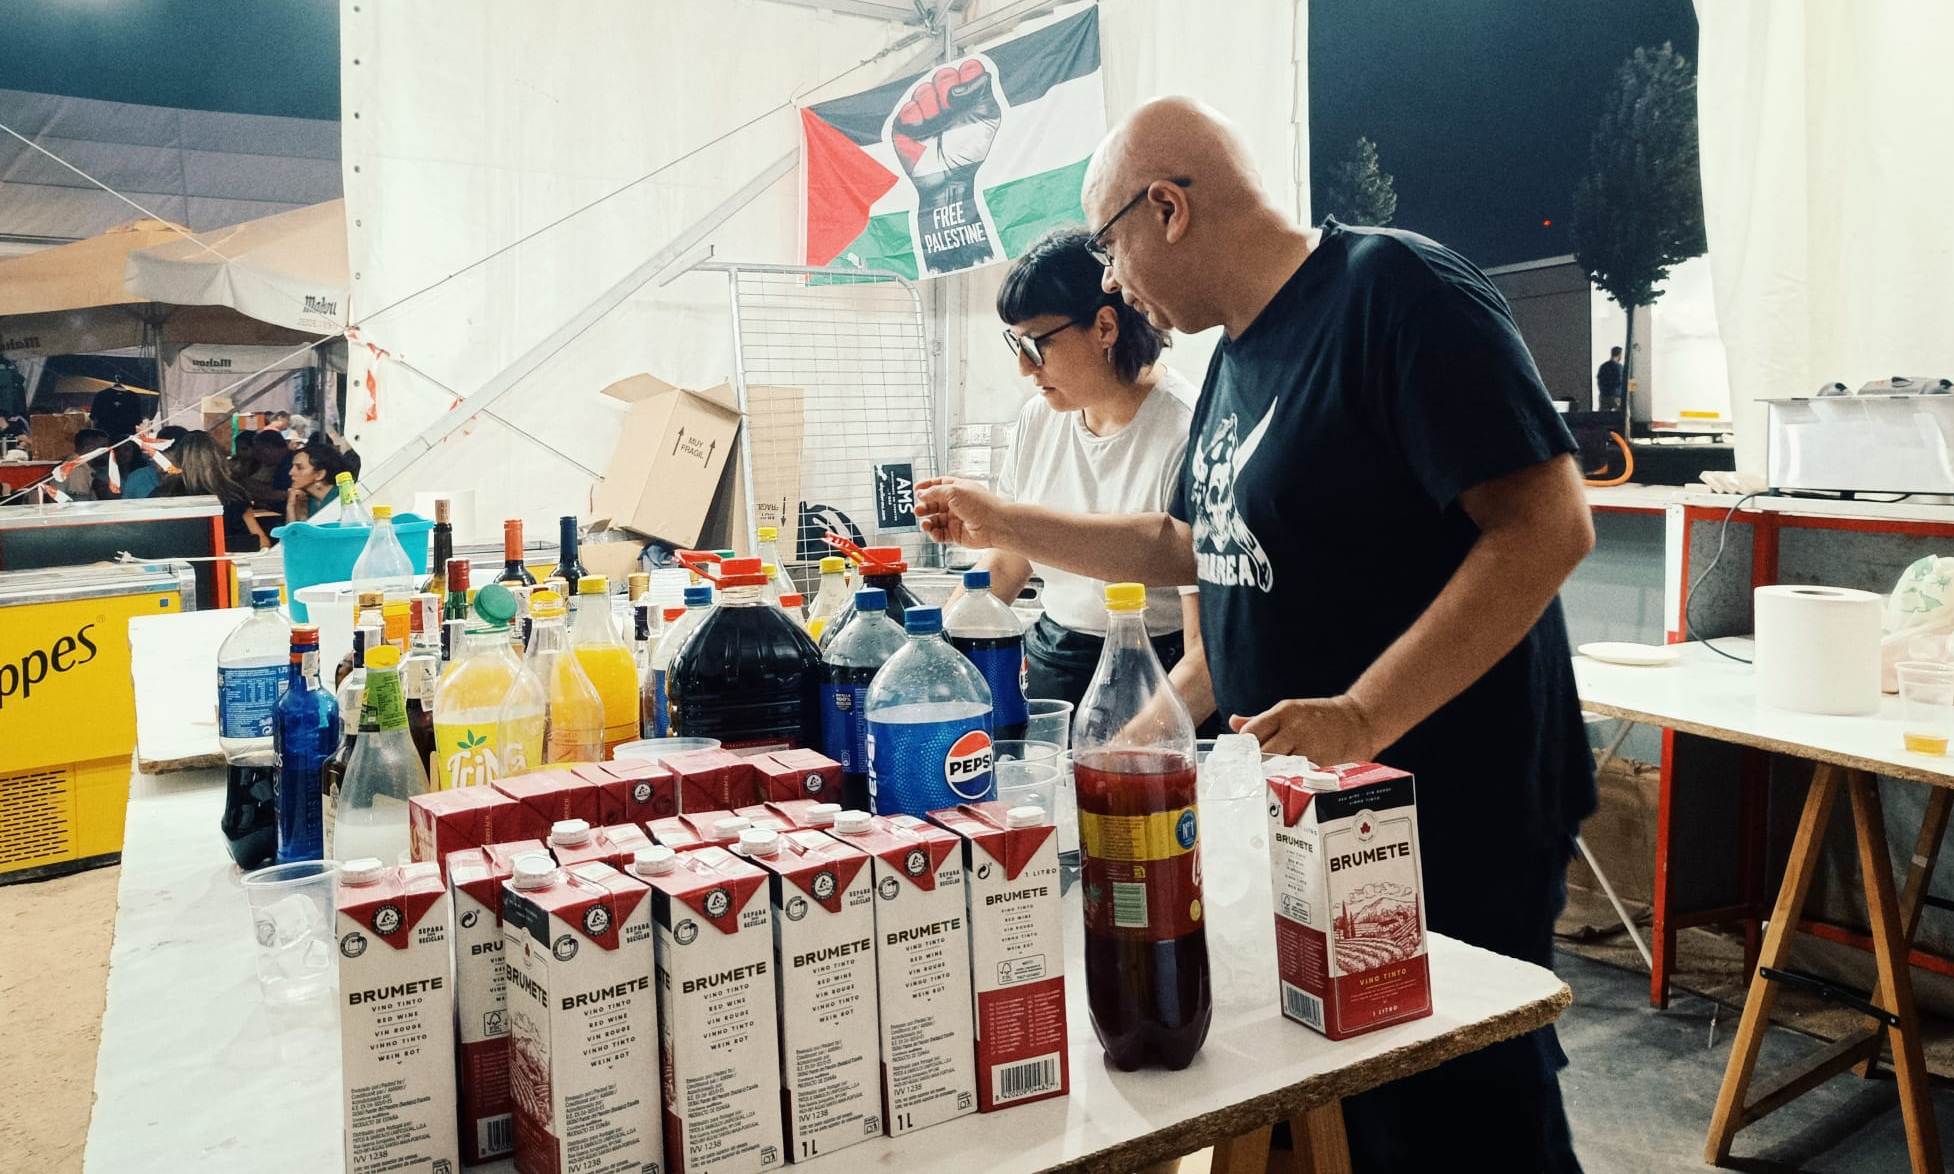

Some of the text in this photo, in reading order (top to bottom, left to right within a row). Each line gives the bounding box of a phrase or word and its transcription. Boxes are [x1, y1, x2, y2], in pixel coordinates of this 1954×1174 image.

[934, 201, 965, 230] FREE
[924, 222, 986, 254] PALESTINE
[303, 296, 336, 315] Mahou
[688, 436, 704, 448] MUY
[896, 478, 914, 514] AMS
[1276, 833, 1314, 853] BRUMETE
[1330, 842, 1410, 872] BRUMETE
[1033, 868, 1057, 877] LITRO
[985, 886, 1048, 906] BRUMETE
[887, 918, 961, 945] BRUMETE
[793, 938, 871, 968] BRUMETE
[682, 961, 767, 994] BRUMETE
[1360, 968, 1406, 986] VINO TINTO
[350, 977, 443, 1006] BRUMETE
[506, 964, 548, 1009] BRUMETE
[562, 976, 649, 1010] BRUMETE
[704, 983, 750, 1000] VINO TINTO
[372, 998, 423, 1012] VINO TINTO
[584, 999, 632, 1016] VINO TINTO
[708, 998, 746, 1012] RED WINE
[397, 1012, 418, 1020] WINE
[589, 1013, 628, 1028] RED WINE
[706, 1010, 749, 1025] VIN ROUGE
[374, 1024, 422, 1037] VIN ROUGE
[586, 1026, 631, 1042] VIN ROUGE
[704, 1020, 754, 1039] VINHO TINTO
[370, 1034, 428, 1050] VINHO TINTO
[582, 1036, 636, 1056] VINHO TINTO
[710, 1036, 749, 1050] WEIN ROT
[378, 1052, 400, 1062] WEIN
[590, 1052, 630, 1068] WEIN ROT
